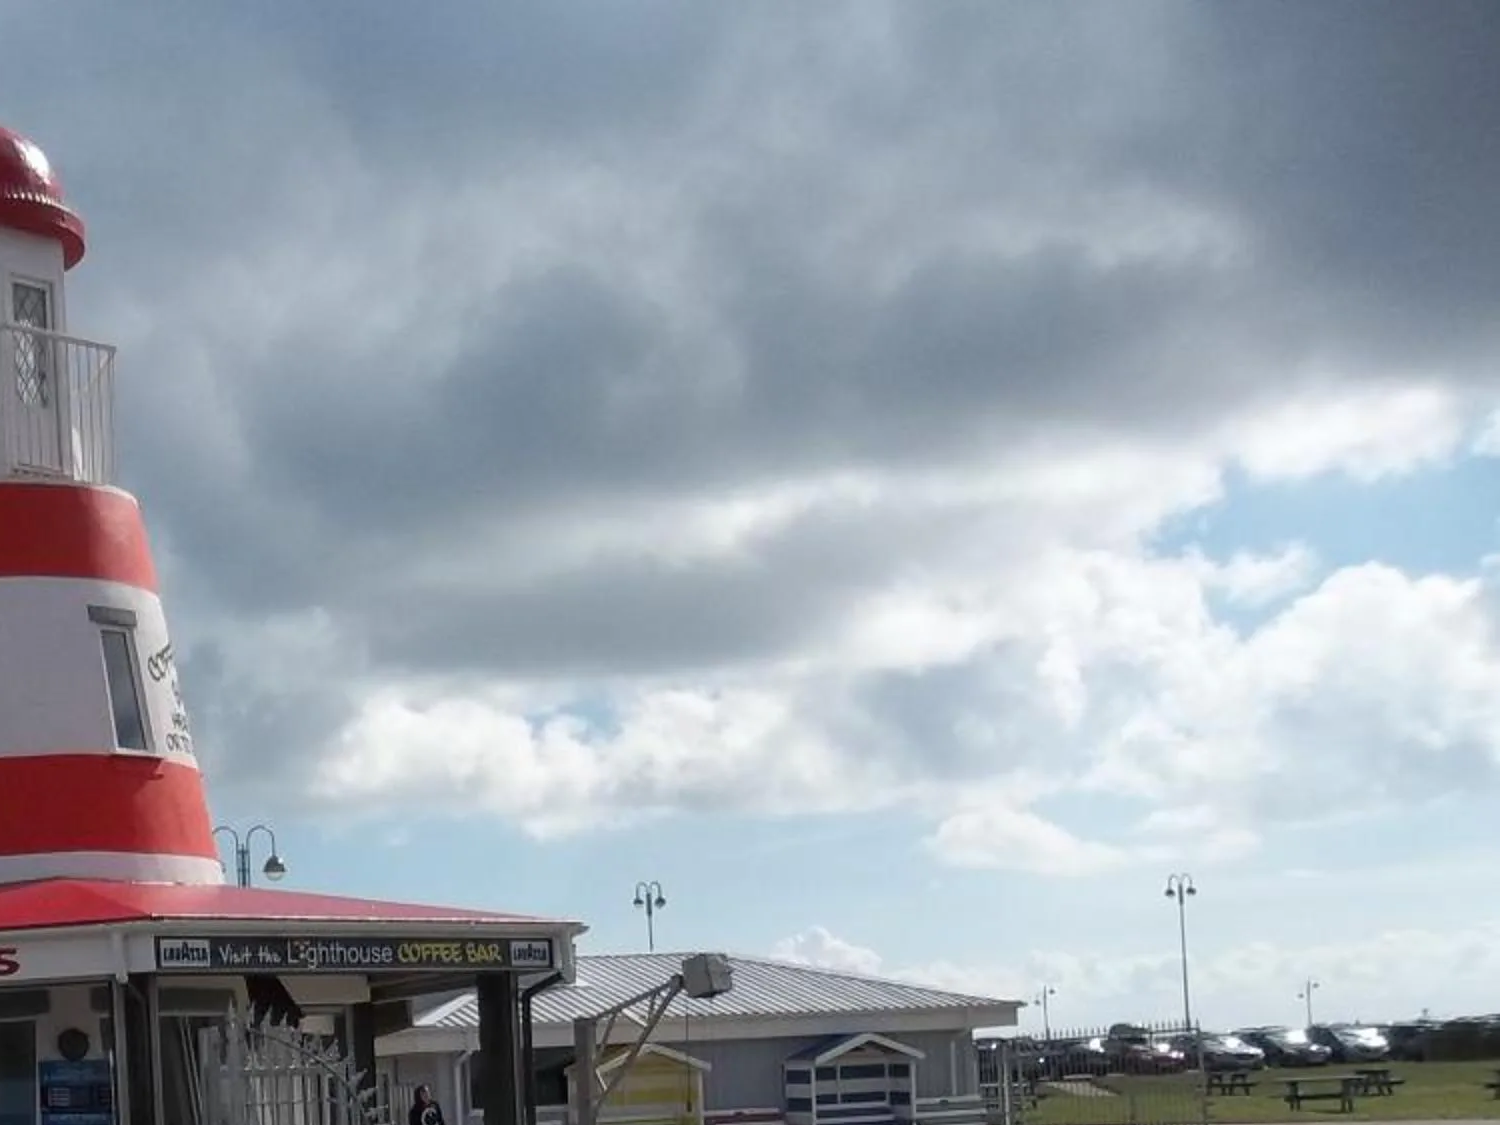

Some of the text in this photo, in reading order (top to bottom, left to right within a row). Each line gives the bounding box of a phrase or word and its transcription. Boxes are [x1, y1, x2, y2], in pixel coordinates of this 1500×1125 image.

[219, 937, 502, 970] Visit the Lighthouse COFFEE BAR
